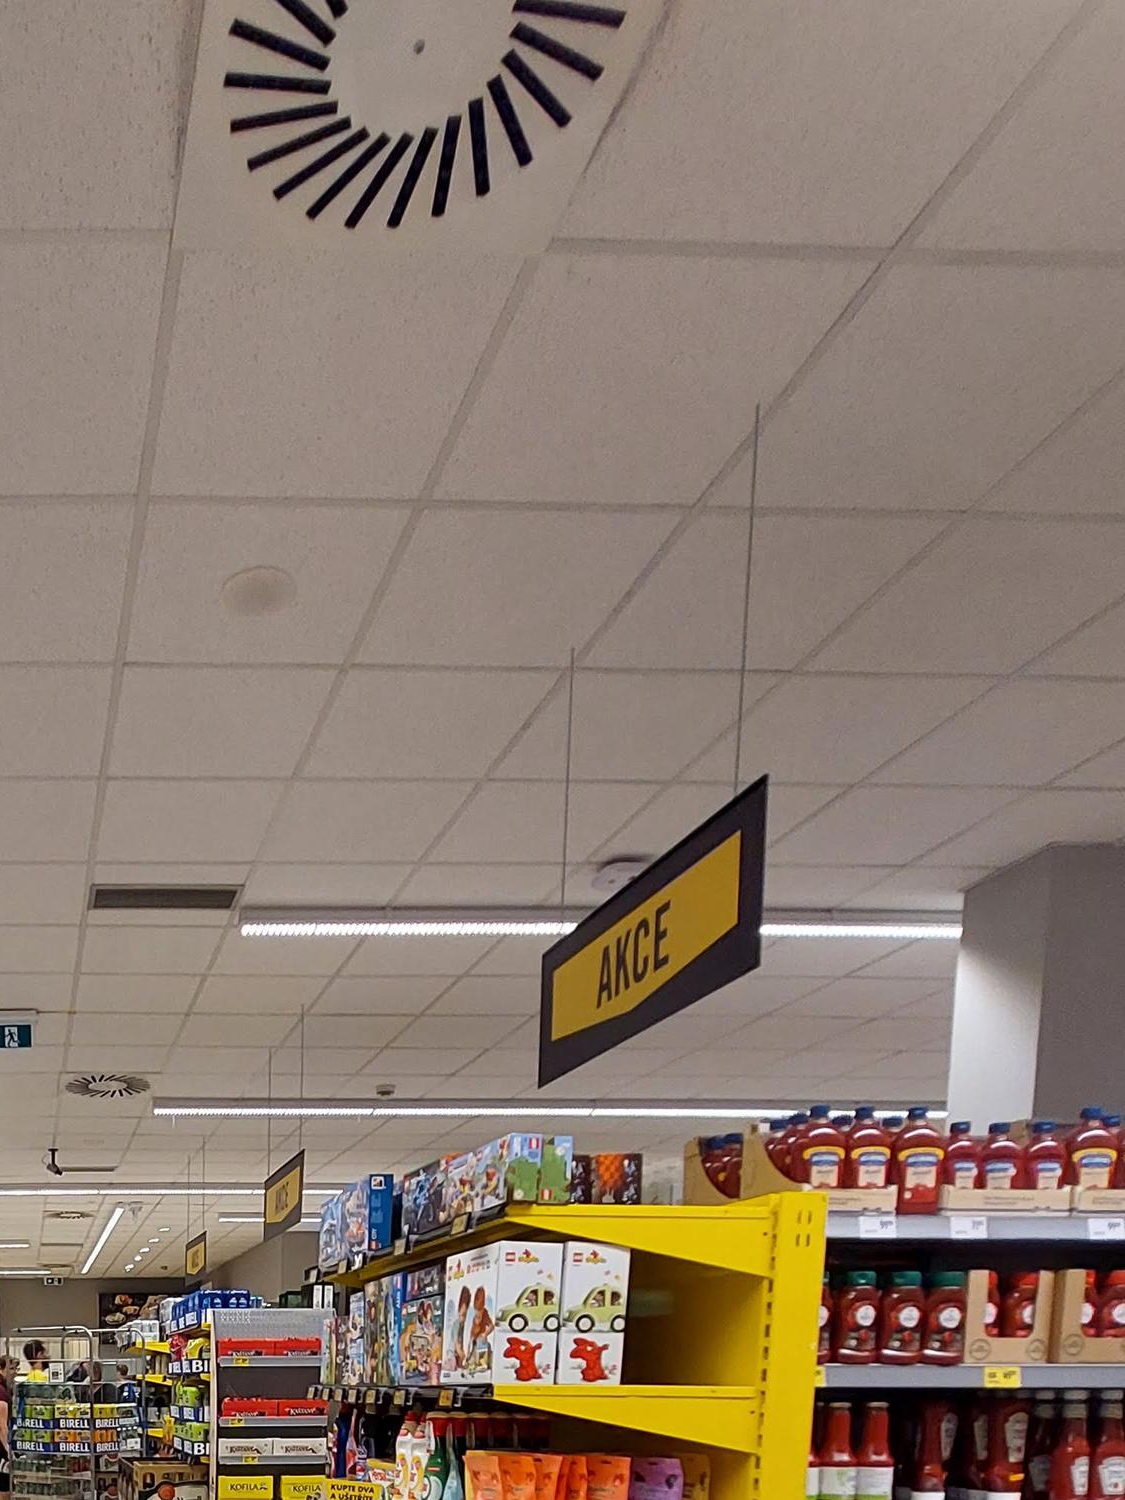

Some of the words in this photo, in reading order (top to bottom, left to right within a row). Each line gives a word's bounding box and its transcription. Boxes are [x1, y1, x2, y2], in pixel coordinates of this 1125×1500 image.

[595, 899, 672, 1010] AKCE
[59, 1418, 90, 1429] BIRELL
[95, 1418, 119, 1428] BIRELL
[16, 1441, 44, 1451] BIRELL
[59, 1442, 90, 1452] BIRELL
[96, 1442, 119, 1452] BIRELL
[230, 1483, 259, 1491] KOFILA
[292, 1484, 321, 1493] KOFILA
[330, 1484, 357, 1493] KUPTE
